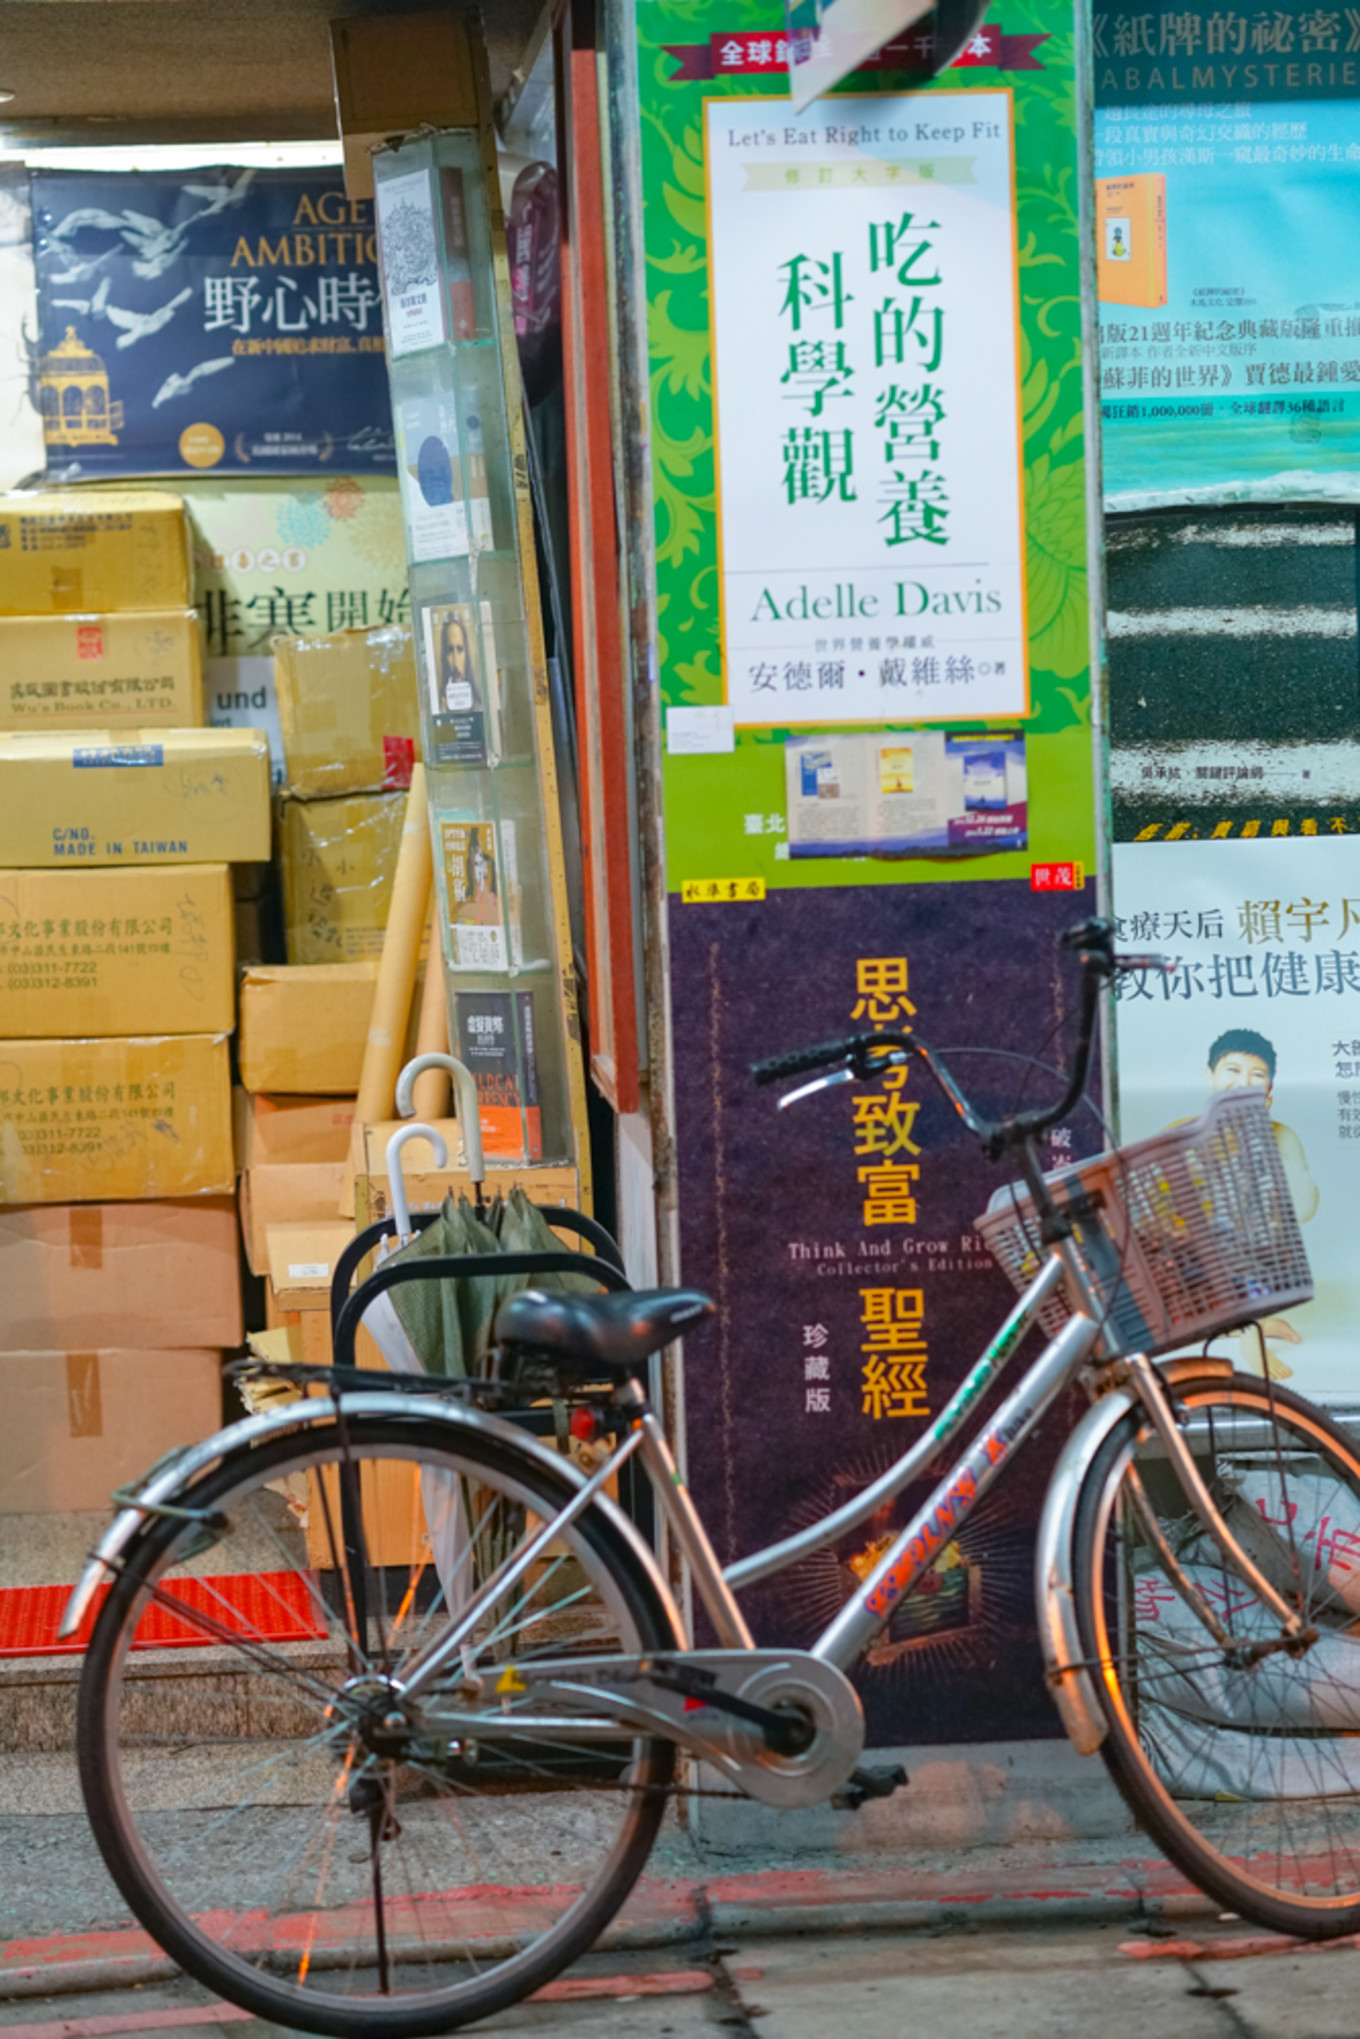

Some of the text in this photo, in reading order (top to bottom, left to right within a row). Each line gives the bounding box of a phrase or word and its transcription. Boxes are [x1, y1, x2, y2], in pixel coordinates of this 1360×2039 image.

[728, 121, 1001, 147] Let's Eat Right to Keep Fit
[784, 162, 935, 185] 修訂大字版
[294, 191, 367, 225] AGE
[203, 272, 384, 334] 野心時
[777, 251, 858, 505] 科學觀
[868, 211, 951, 548] 吃的營養
[749, 576, 1002, 622] Adelle Davis
[217, 685, 267, 710] und
[53, 827, 96, 841] C/NO.
[53, 840, 188, 856] MADE IN TAIWAN
[788, 1241, 846, 1260] Think
[858, 1239, 891, 1257] And
[902, 1237, 948, 1255] Grow
[817, 1257, 994, 1277] Collector's Edition
[802, 1323, 832, 1414] 珍藏版
[858, 1287, 930, 1420] 聖經
